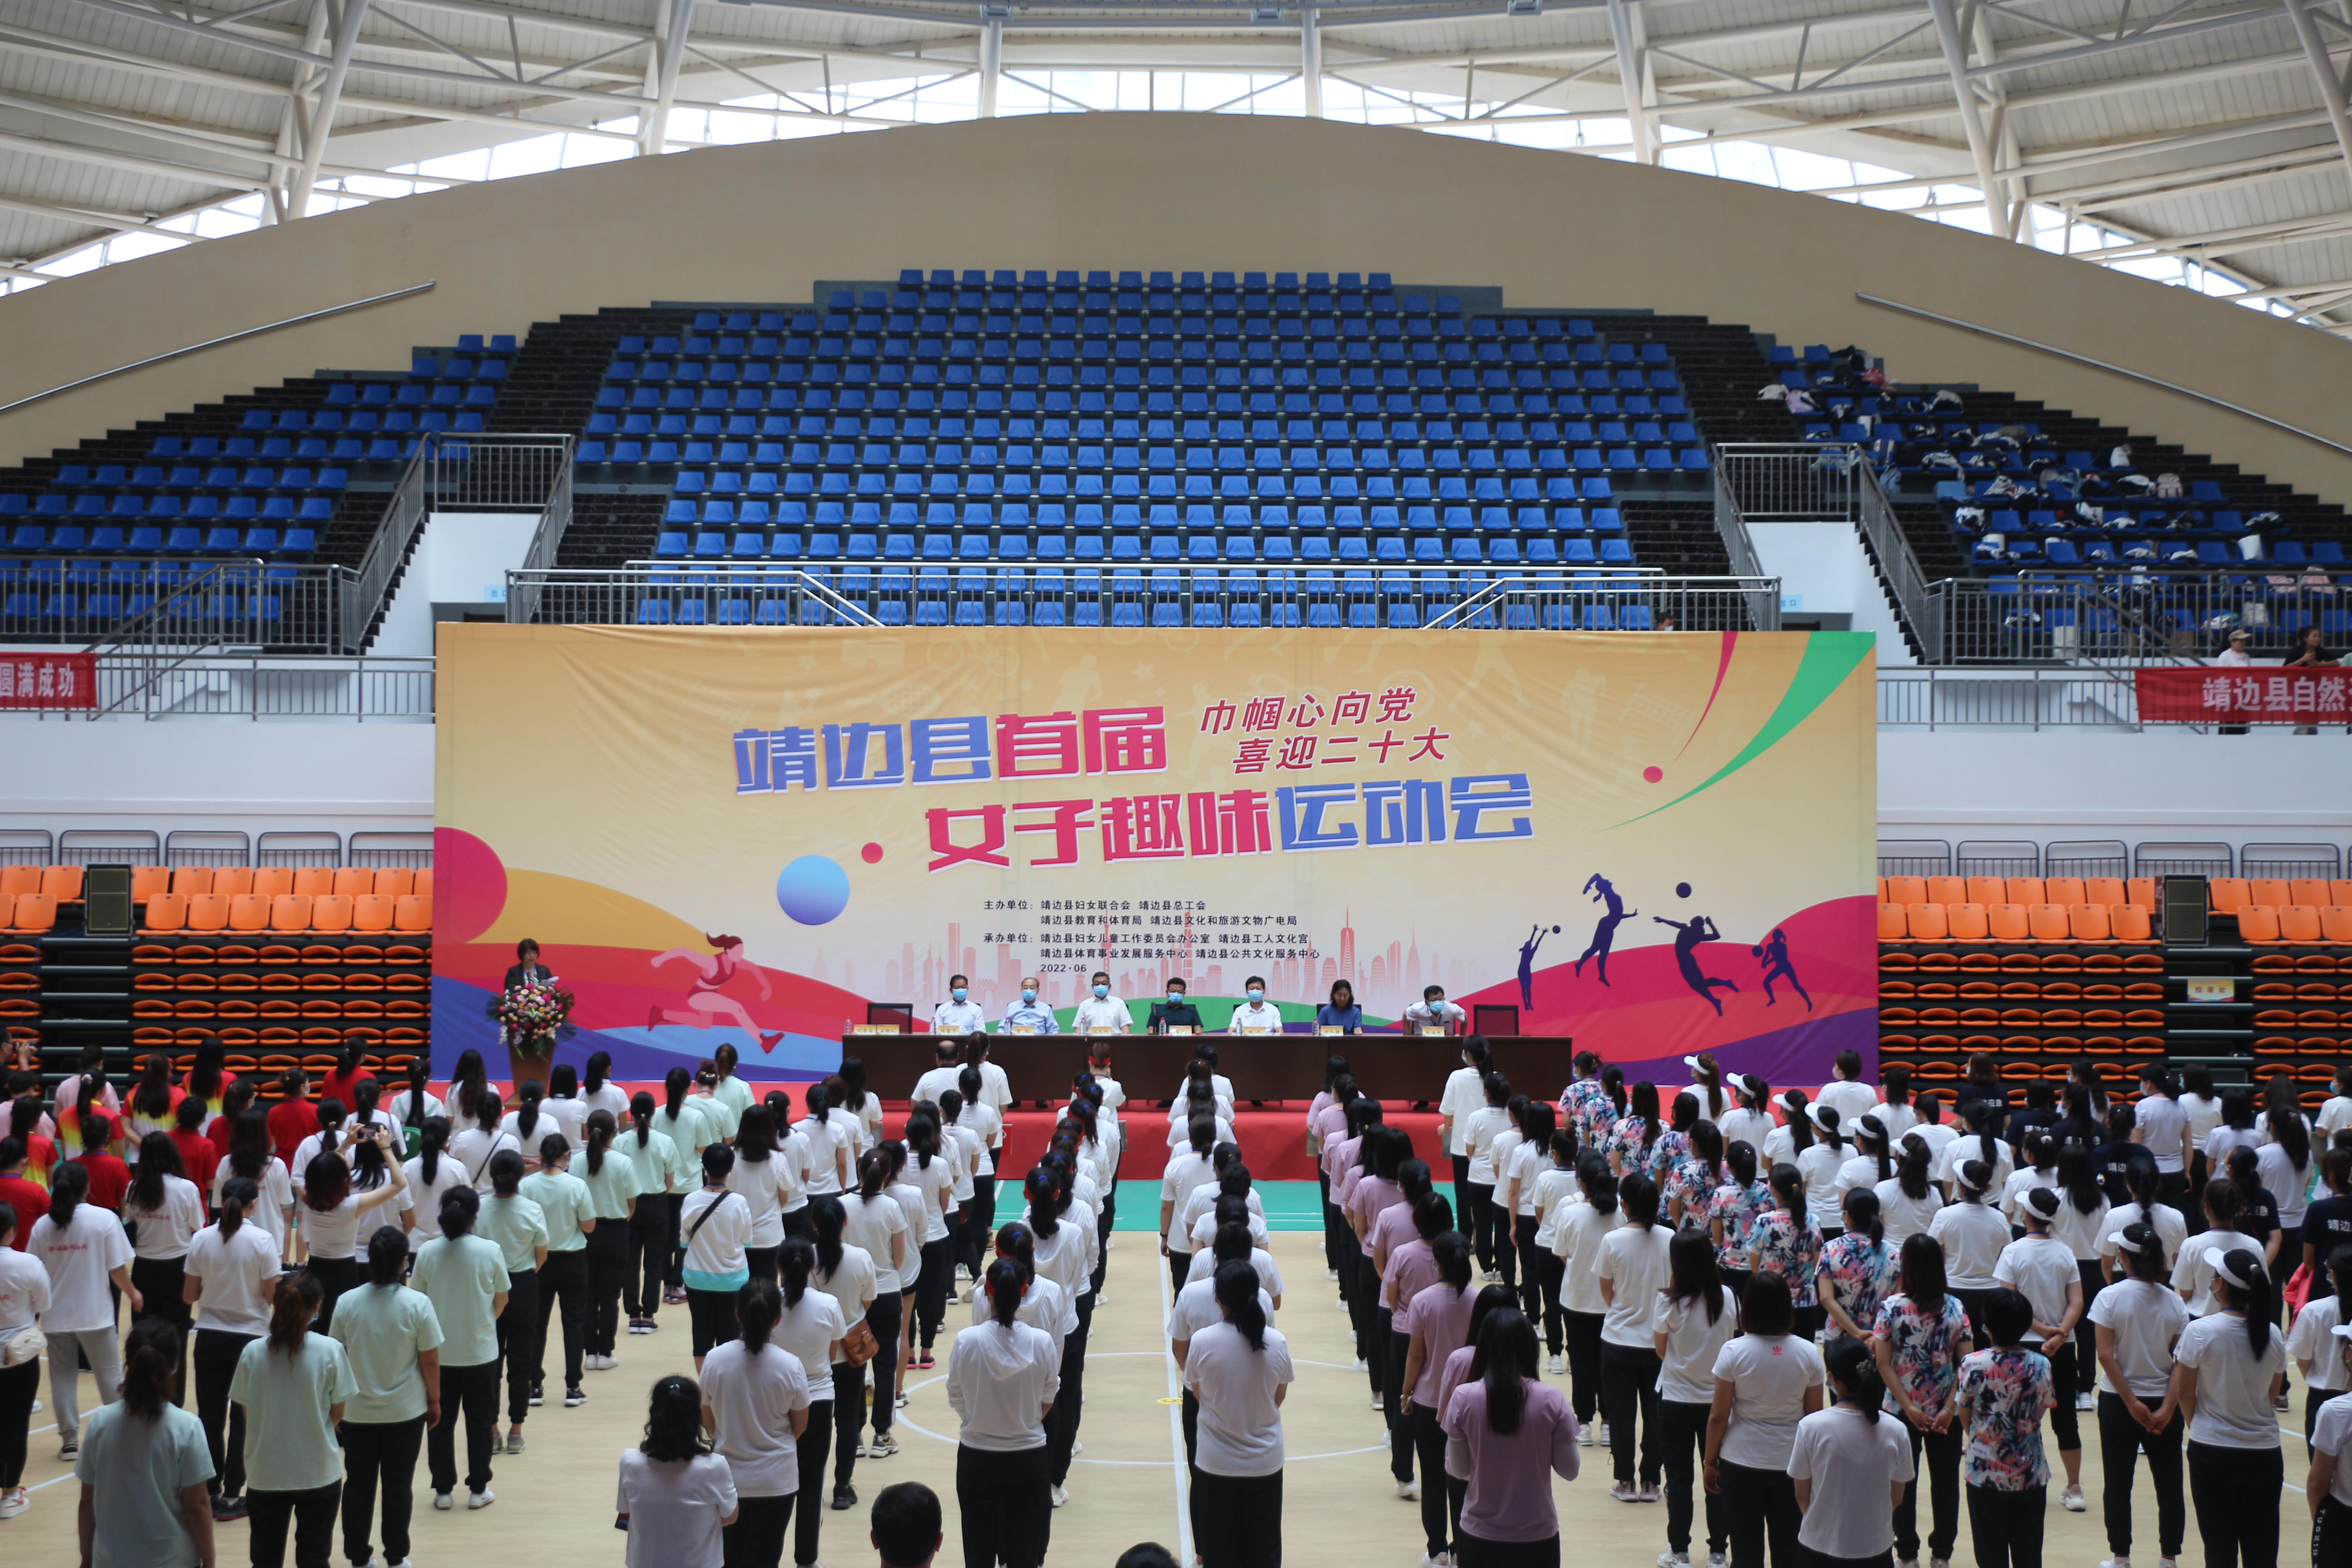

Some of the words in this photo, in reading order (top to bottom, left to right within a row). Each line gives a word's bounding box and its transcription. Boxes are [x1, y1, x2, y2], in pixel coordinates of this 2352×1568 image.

[0, 662, 74, 697] 圆满成功
[2203, 676, 2352, 711] 靖边县自然
[1200, 686, 1417, 735] 巾帼心向党
[733, 706, 1168, 793] 靖边县首届
[1231, 726, 1451, 774] 喜迎二十大
[926, 773, 1533, 872] 女子趣味运动会
[1041, 900, 1131, 910] 靖边县妇女联合会
[1139, 900, 1206, 910] 靖边县总工会
[1041, 915, 1142, 925] 靖边县教育和体育局
[1150, 915, 1297, 926] 靖边县文化和旅游文物广电局
[1041, 933, 1210, 943] 靖边县妇女儿童工作委员会办公室
[1219, 934, 1308, 944] 靖边县工人文化宫
[1041, 948, 1188, 958] 靖边县体育事业发展服务中心
[1196, 949, 1320, 959] 靖边县公共文化服务中心
[2327, 1219, 2352, 1232] 靖边
